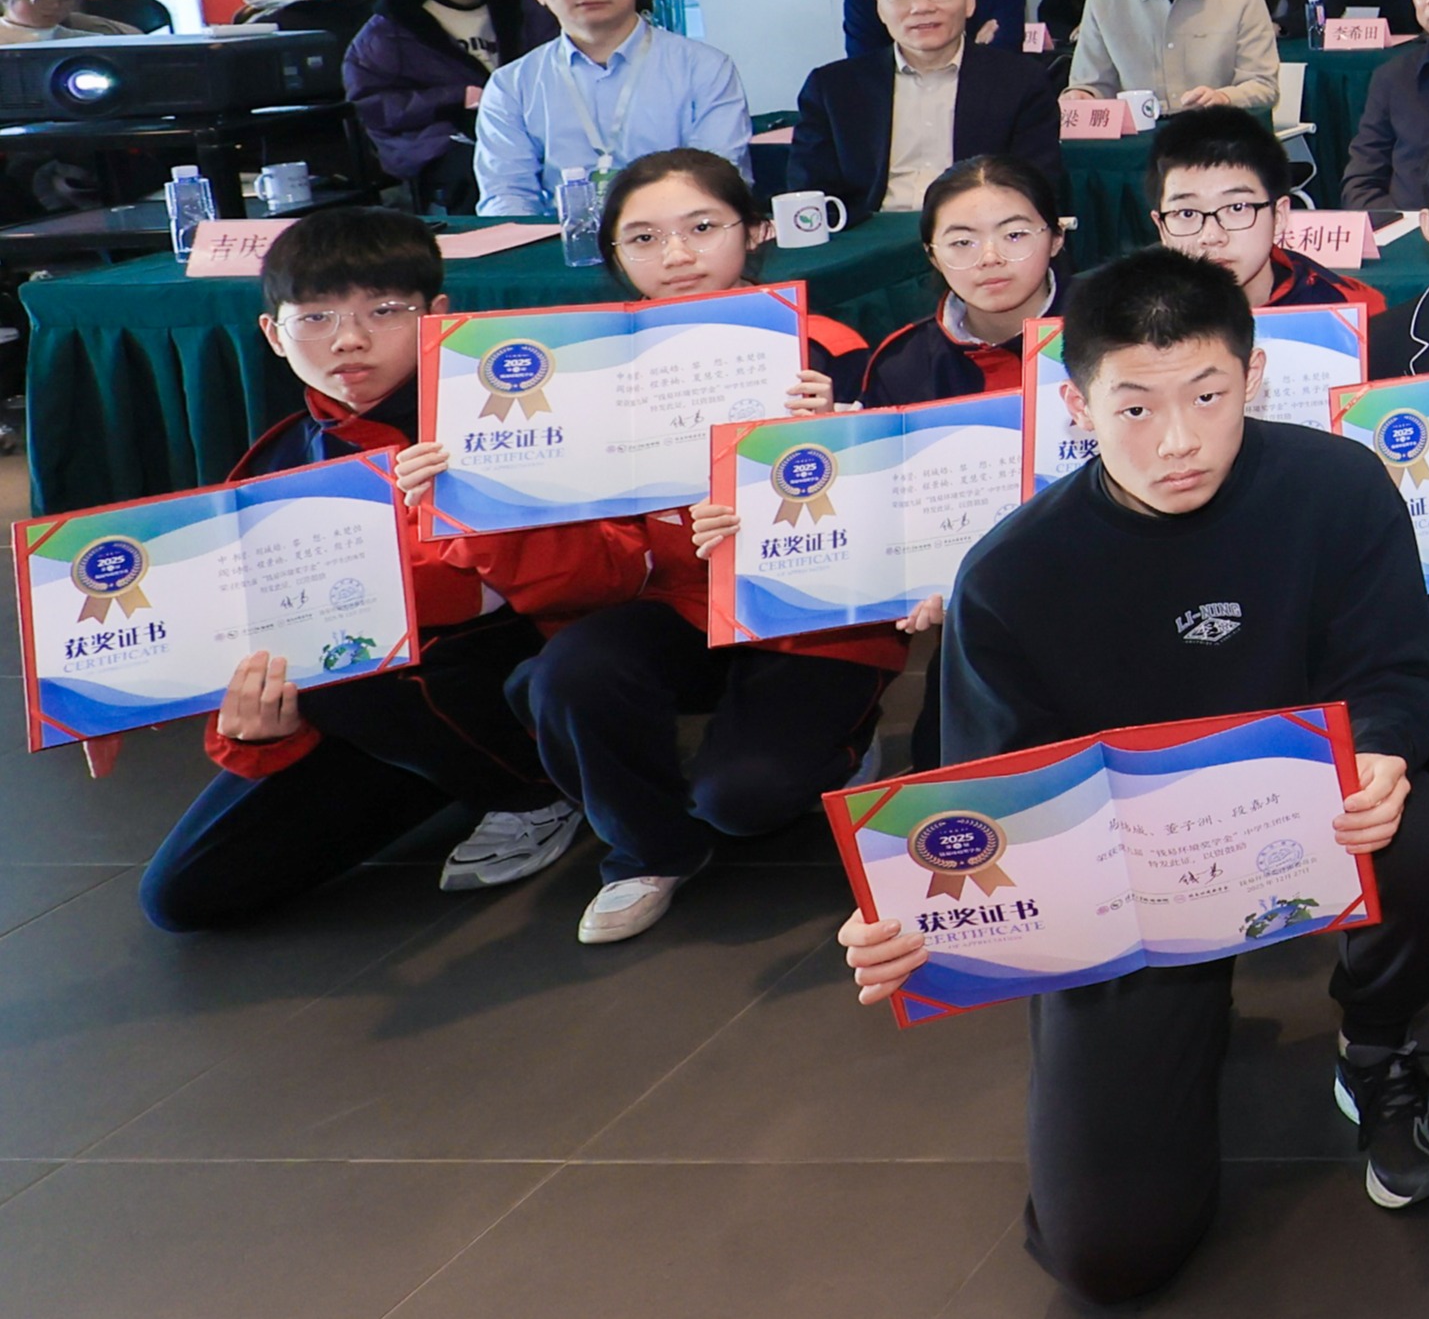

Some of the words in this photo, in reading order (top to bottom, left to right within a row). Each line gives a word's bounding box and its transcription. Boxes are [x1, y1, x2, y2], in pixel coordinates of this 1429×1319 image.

[503, 358, 532, 368] 2025
[464, 426, 564, 454] 获奖证书
[1058, 438, 1099, 460] 获奖
[460, 447, 566, 467] CERTIFICATE
[760, 528, 848, 559] 获奖证书
[758, 550, 850, 573] CERTIFICATE
[1175, 602, 1242, 633] LI-NING
[64, 620, 168, 660] 获奖证书
[63, 643, 171, 674] CERTIFICATE
[939, 832, 975, 846] 2025
[914, 898, 1040, 933] 获奖证书
[923, 920, 1046, 948] CERTIFICATE
